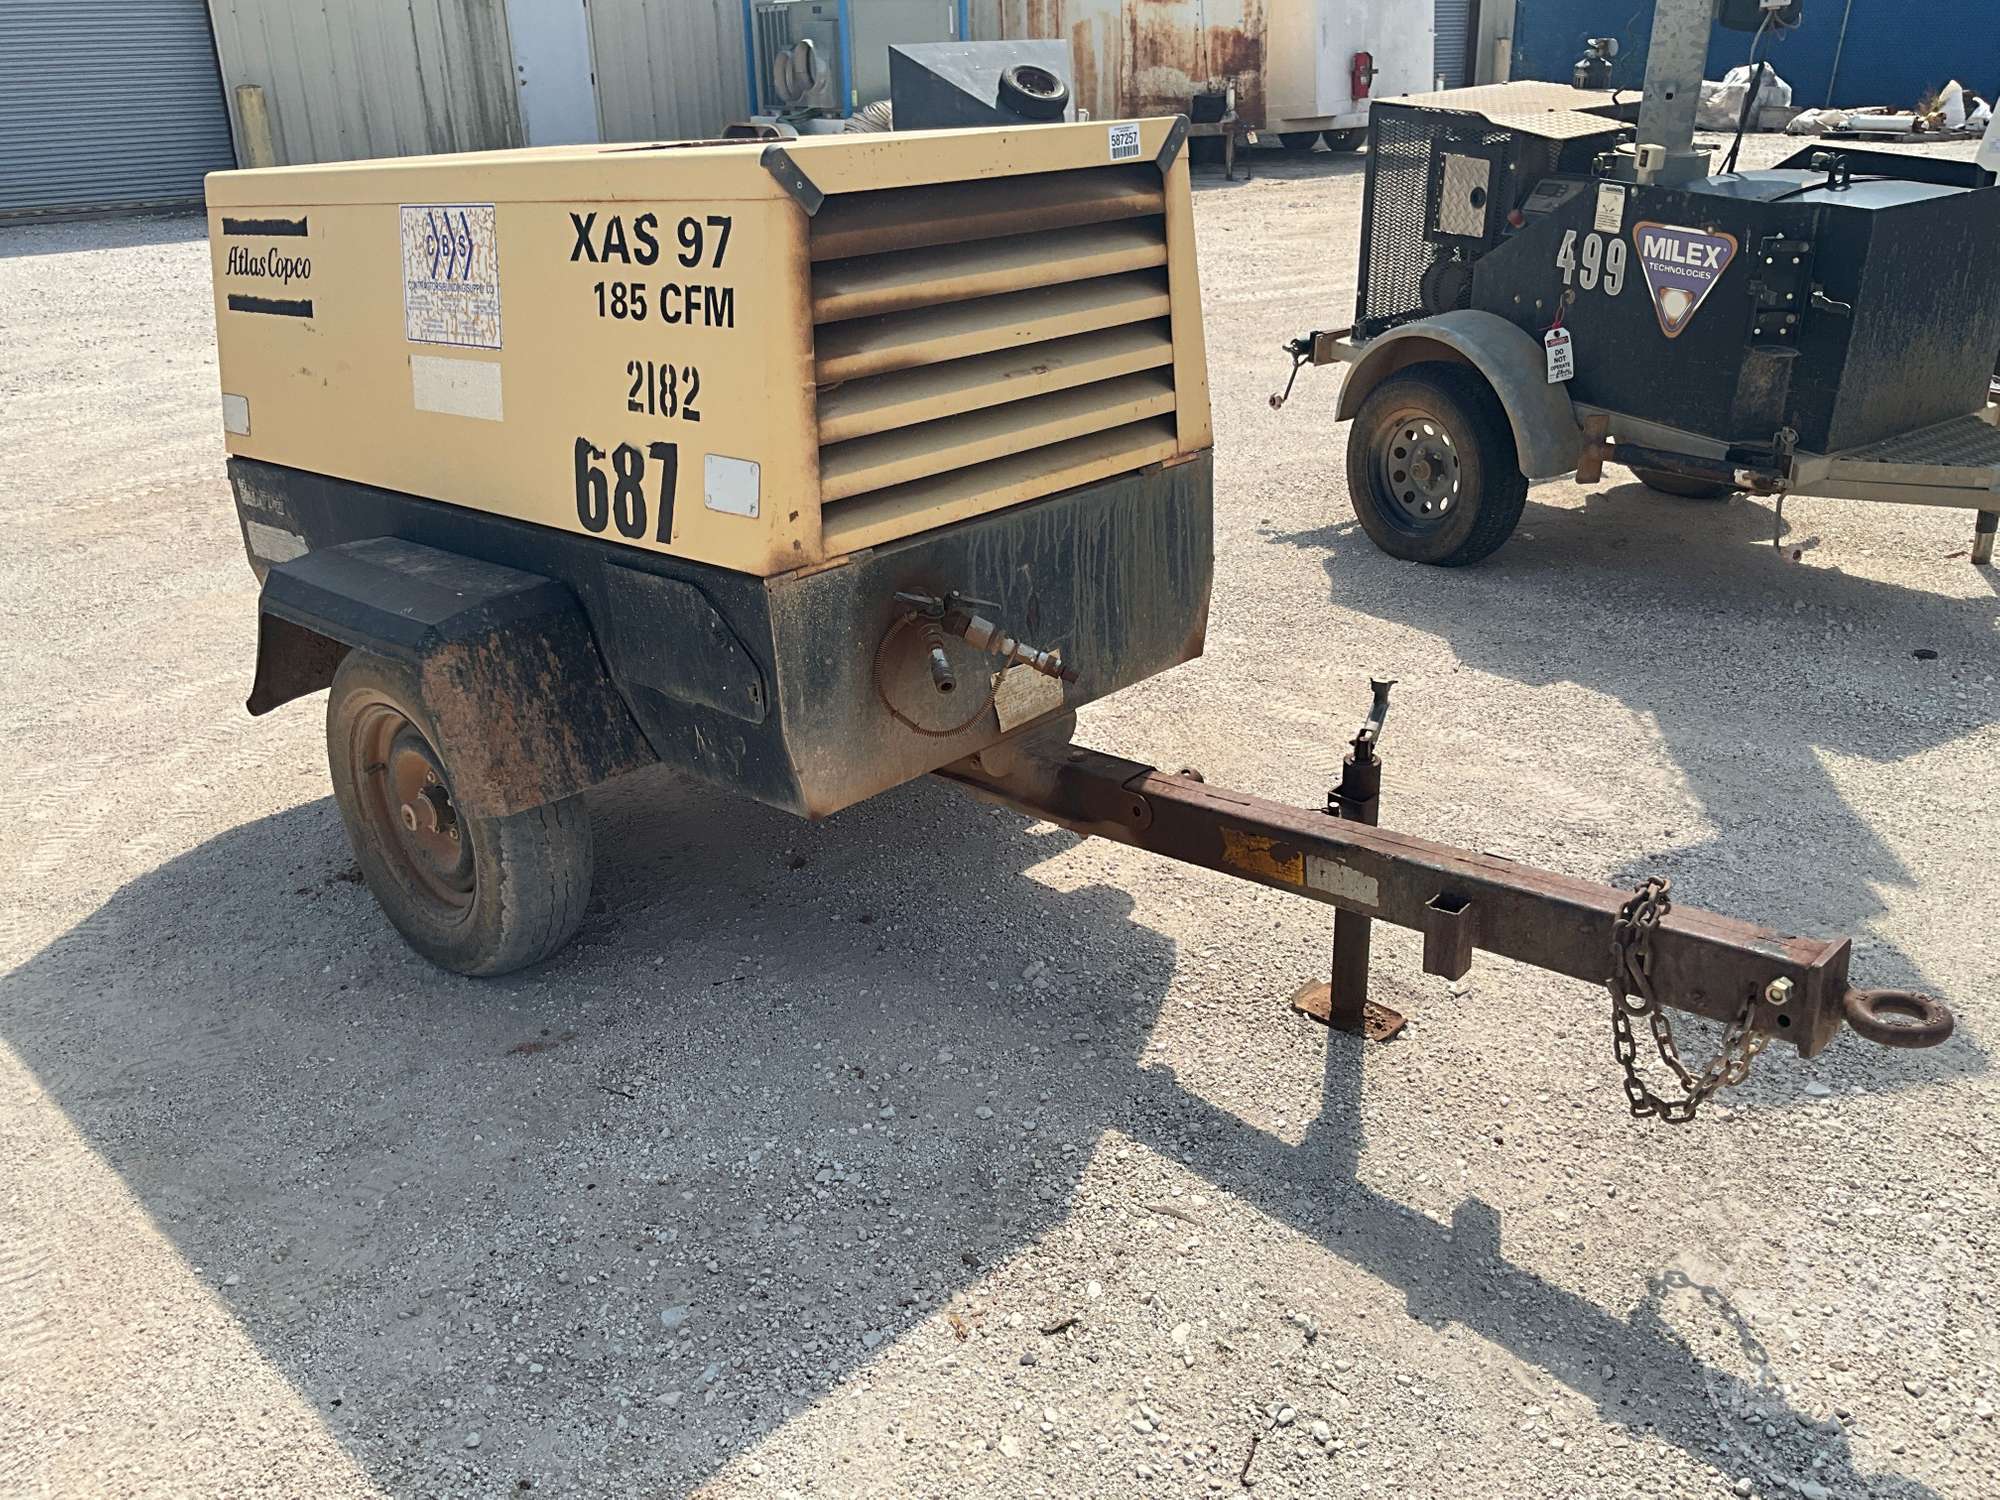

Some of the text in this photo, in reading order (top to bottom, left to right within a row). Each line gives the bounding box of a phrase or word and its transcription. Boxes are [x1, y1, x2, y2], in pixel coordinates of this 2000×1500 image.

[1111, 132, 1137, 146] 587257
[569, 212, 732, 268] XAS 97
[1643, 235, 1722, 269] MILEX
[225, 246, 311, 286] Atlas Copco
[1556, 230, 1628, 296] 499
[1649, 262, 1711, 280] TECHNOLOGIES
[594, 281, 734, 328] 185 CFM
[1550, 362, 1571, 371] OPERATE
[1553, 355, 1567, 364] NOT
[1554, 348, 1564, 356] DO
[627, 360, 700, 422] 2182
[574, 436, 678, 544] 687
